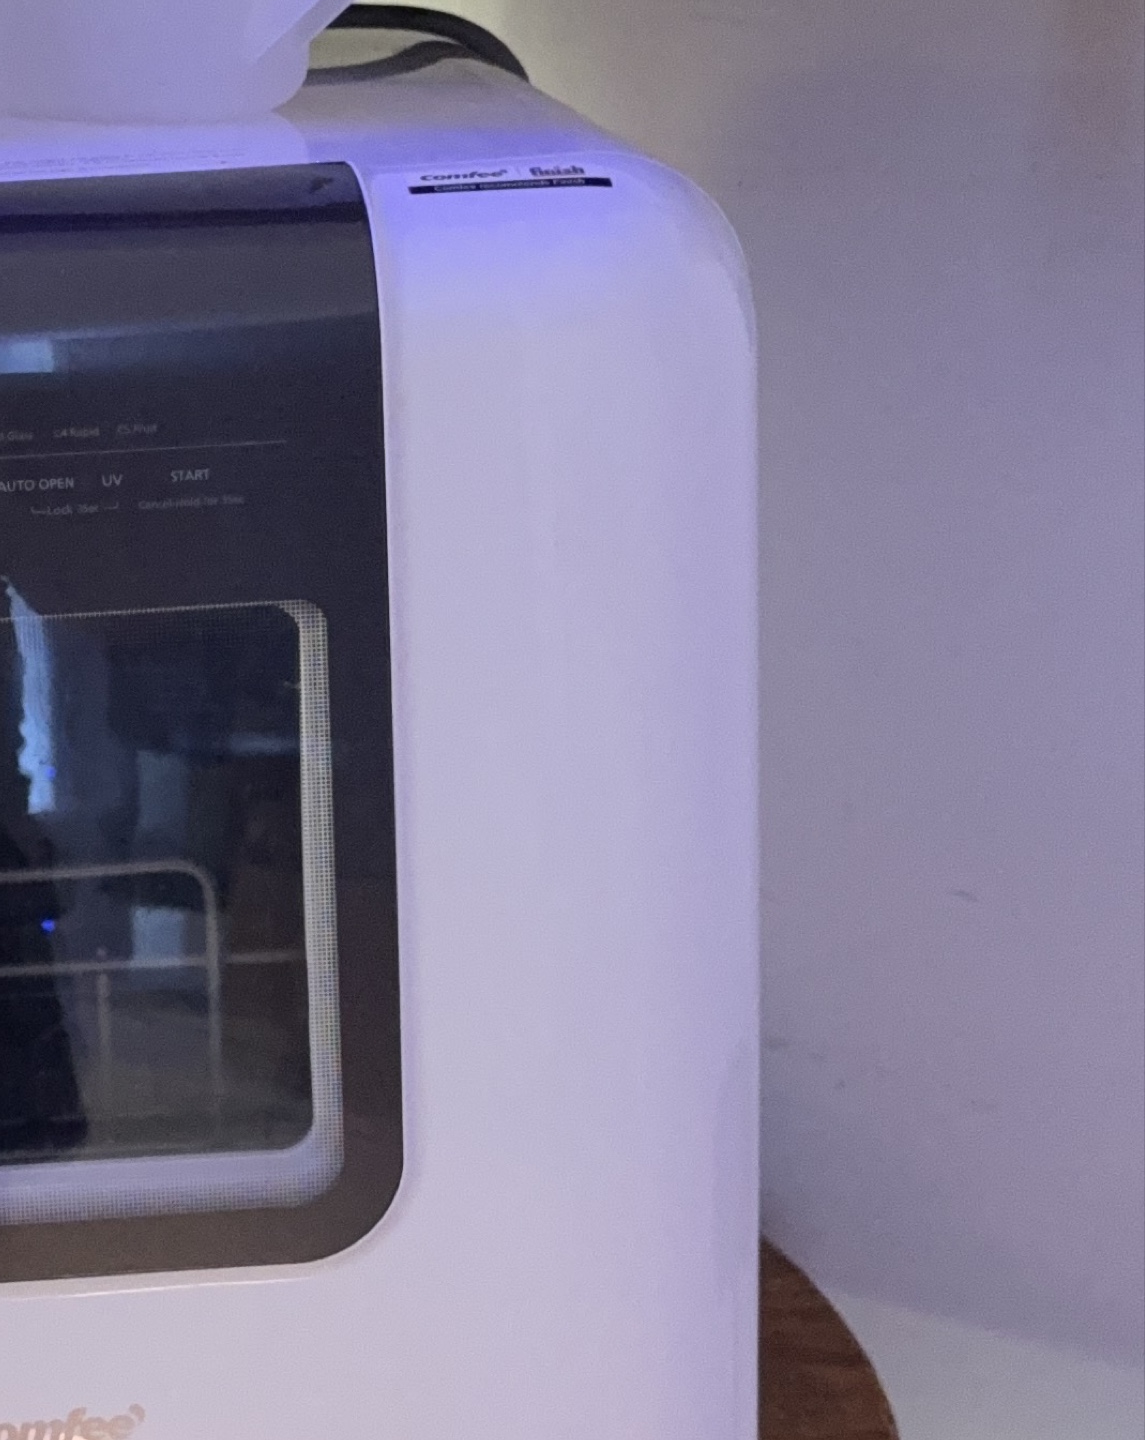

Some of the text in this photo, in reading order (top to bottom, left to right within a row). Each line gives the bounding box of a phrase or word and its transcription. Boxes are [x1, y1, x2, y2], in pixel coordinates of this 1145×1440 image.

[102, 473, 123, 488] UV
[170, 468, 211, 483] START
[38, 477, 75, 491] OPEN
